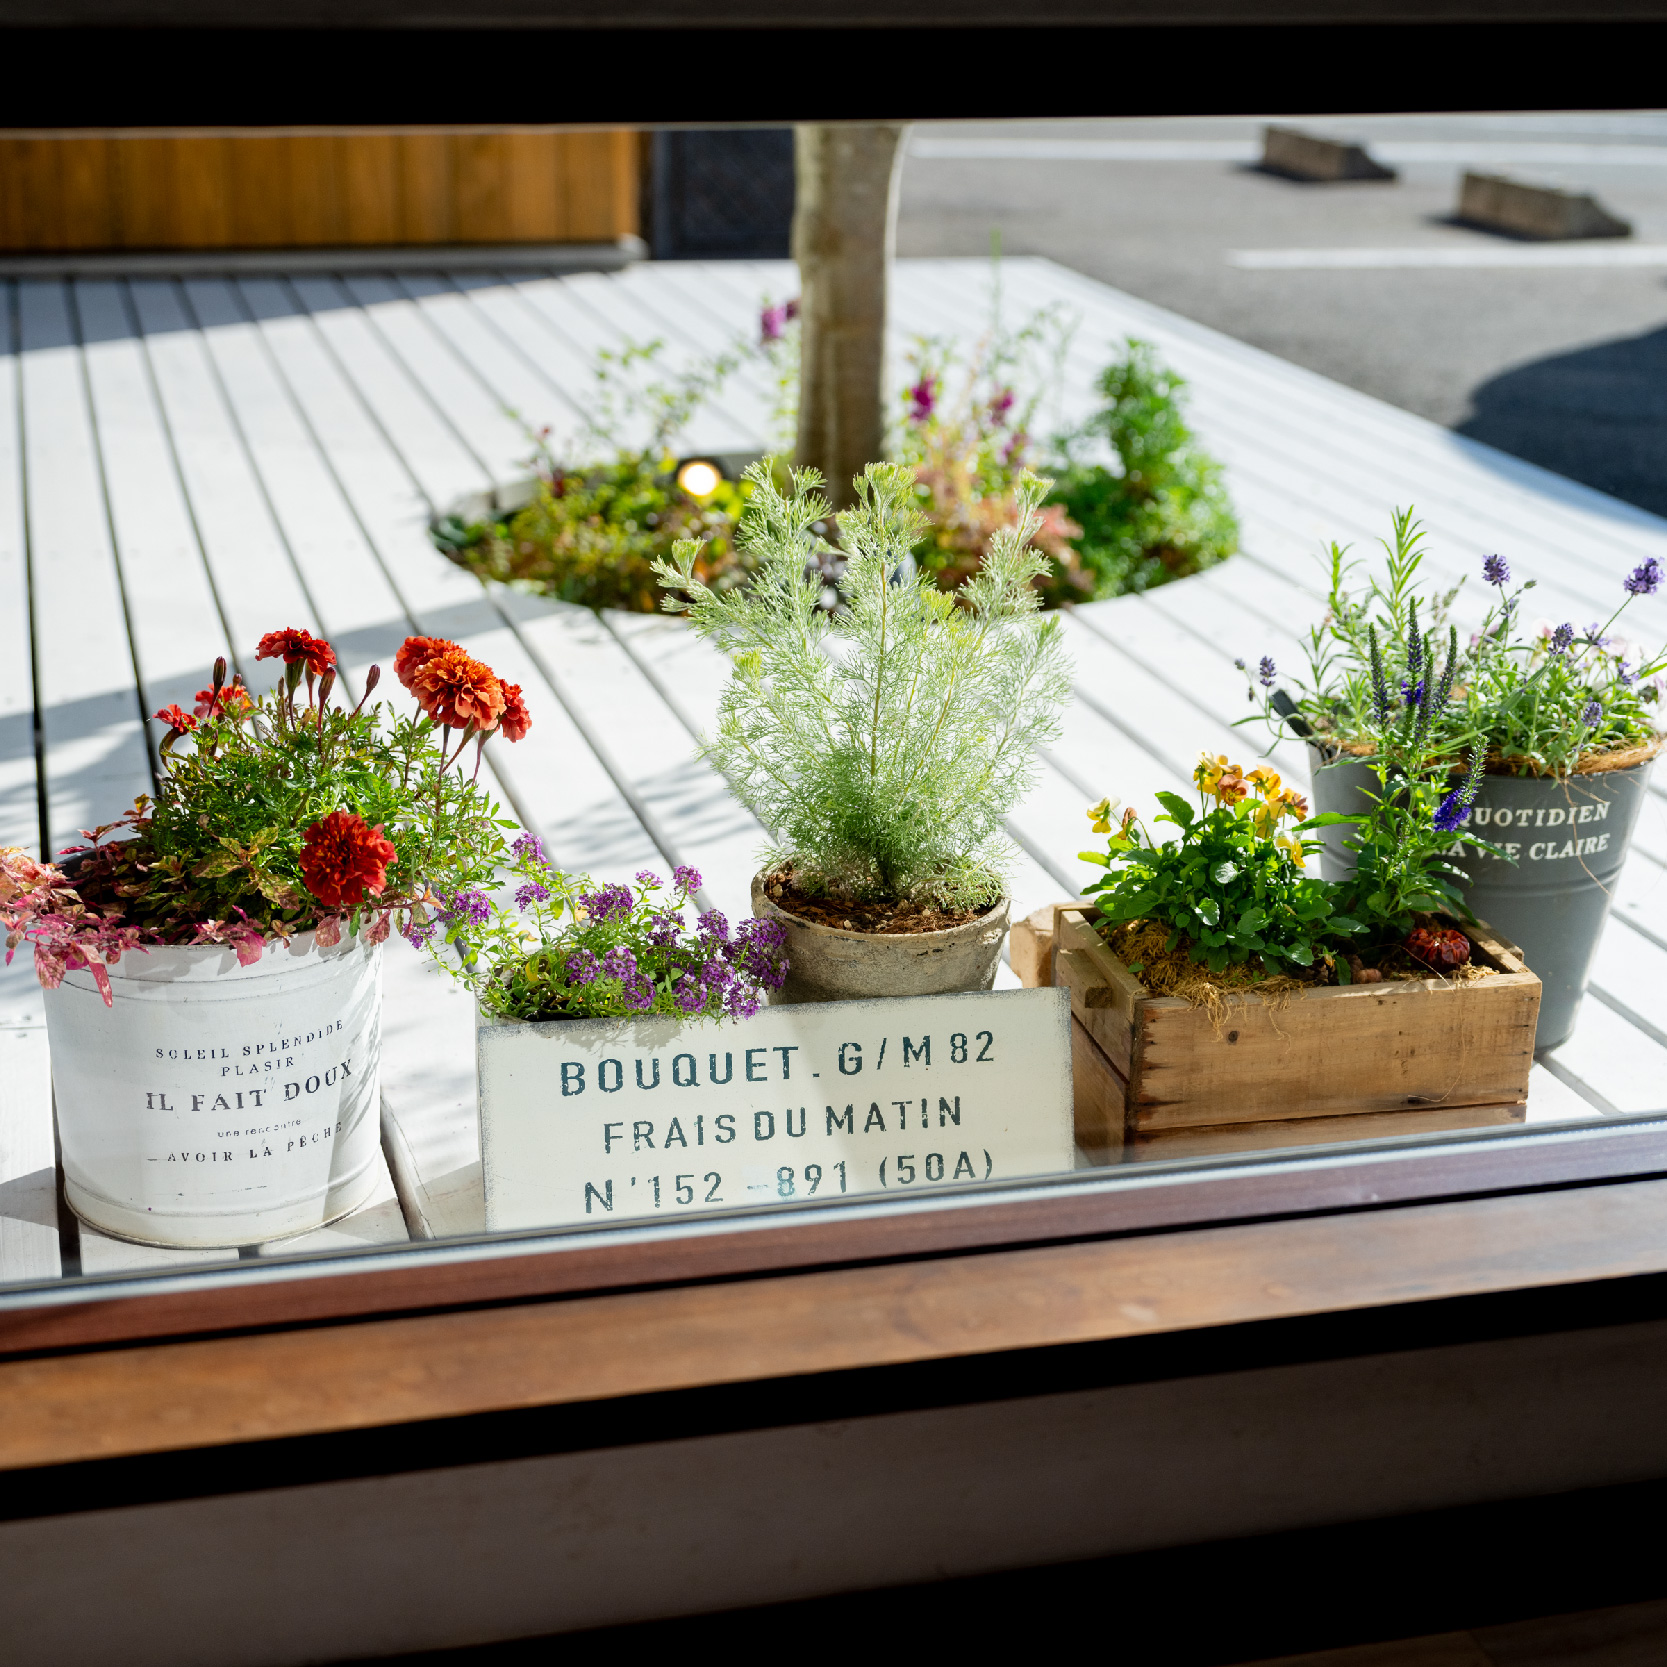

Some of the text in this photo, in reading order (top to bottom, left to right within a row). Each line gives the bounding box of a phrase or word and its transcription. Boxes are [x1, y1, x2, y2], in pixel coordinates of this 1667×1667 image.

[1529, 833, 1611, 861] CLAIRE
[155, 1020, 344, 1060] SOLEIL SPLENDIDE
[145, 1058, 352, 1112] IL FAIT DOUX
[221, 1056, 294, 1077] PLASIR
[603, 1095, 962, 1155] FRAIS DU MATIN
[167, 1151, 233, 1163] AVOIR
[249, 1146, 273, 1159] LA
[878, 1148, 994, 1190] (50A)
